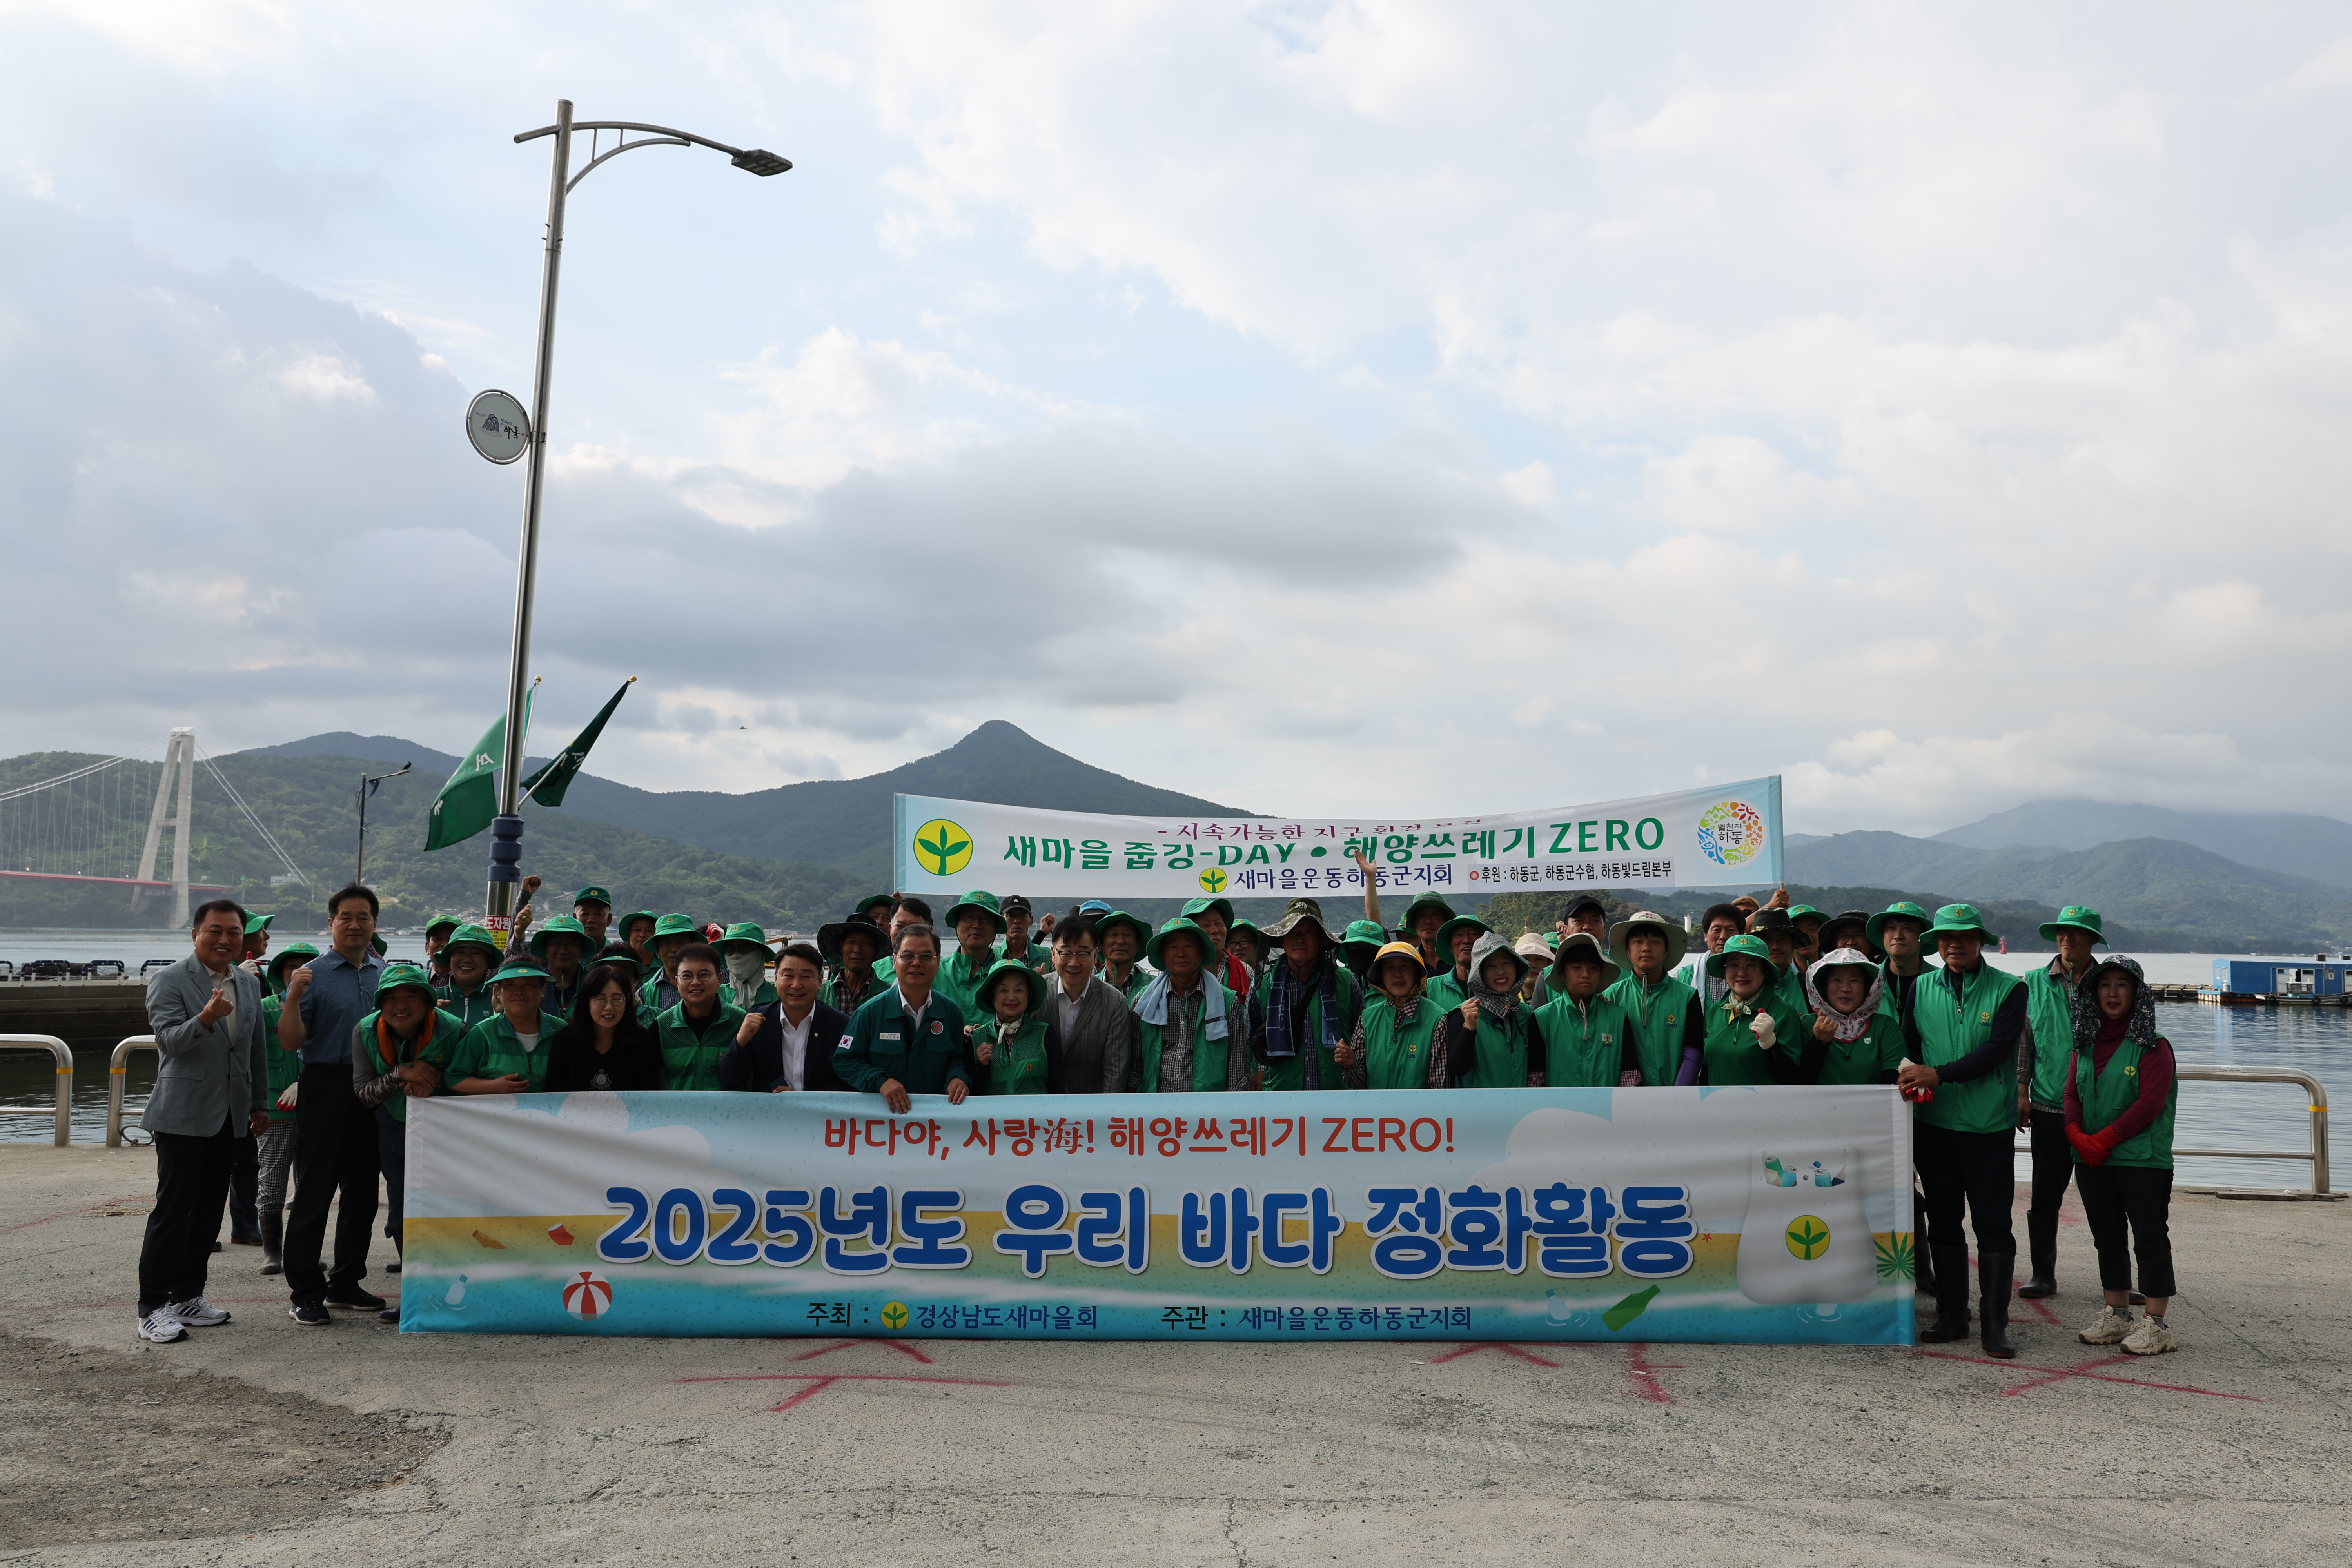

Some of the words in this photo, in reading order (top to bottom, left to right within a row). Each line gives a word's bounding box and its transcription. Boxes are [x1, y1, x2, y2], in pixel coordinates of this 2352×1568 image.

[504, 426, 521, 439] 하동
[1176, 822, 1305, 840] 지속가능한
[1313, 825, 1364, 838] 지구
[1373, 824, 1421, 834] 환경
[1718, 823, 1742, 831] 별천지
[1718, 831, 1743, 845] 하동
[1004, 835, 1113, 870] 새마을
[1124, 842, 1296, 870] 줍깅-DAY
[1343, 826, 1535, 864] 해양쓰레기
[1549, 817, 1664, 853] ZERO
[1234, 863, 1452, 889] 새마을운동하동군지회
[1481, 866, 1501, 883] 후원
[1510, 866, 1542, 882] 하동군,
[1545, 863, 1598, 881] 하동군수협,
[1601, 860, 1672, 879] 하동빛드림본부
[485, 916, 510, 929] 도자원
[824, 1117, 950, 1161] 바다야,
[963, 1118, 1095, 1157] 사랑海!
[1107, 1116, 1306, 1157] 해양쓰레기
[1322, 1117, 1455, 1153] ZERO!
[597, 1182, 972, 1276] 2025년도
[993, 1181, 1150, 1278] 우리
[1178, 1183, 1345, 1275] 바다
[1363, 1178, 1697, 1279] 정화활동
[806, 1302, 851, 1328] 주최
[915, 1305, 1097, 1330] 경상남도새마을회
[1161, 1305, 1209, 1331] 주관
[1239, 1305, 1472, 1331] 새마을운동하동군지회
